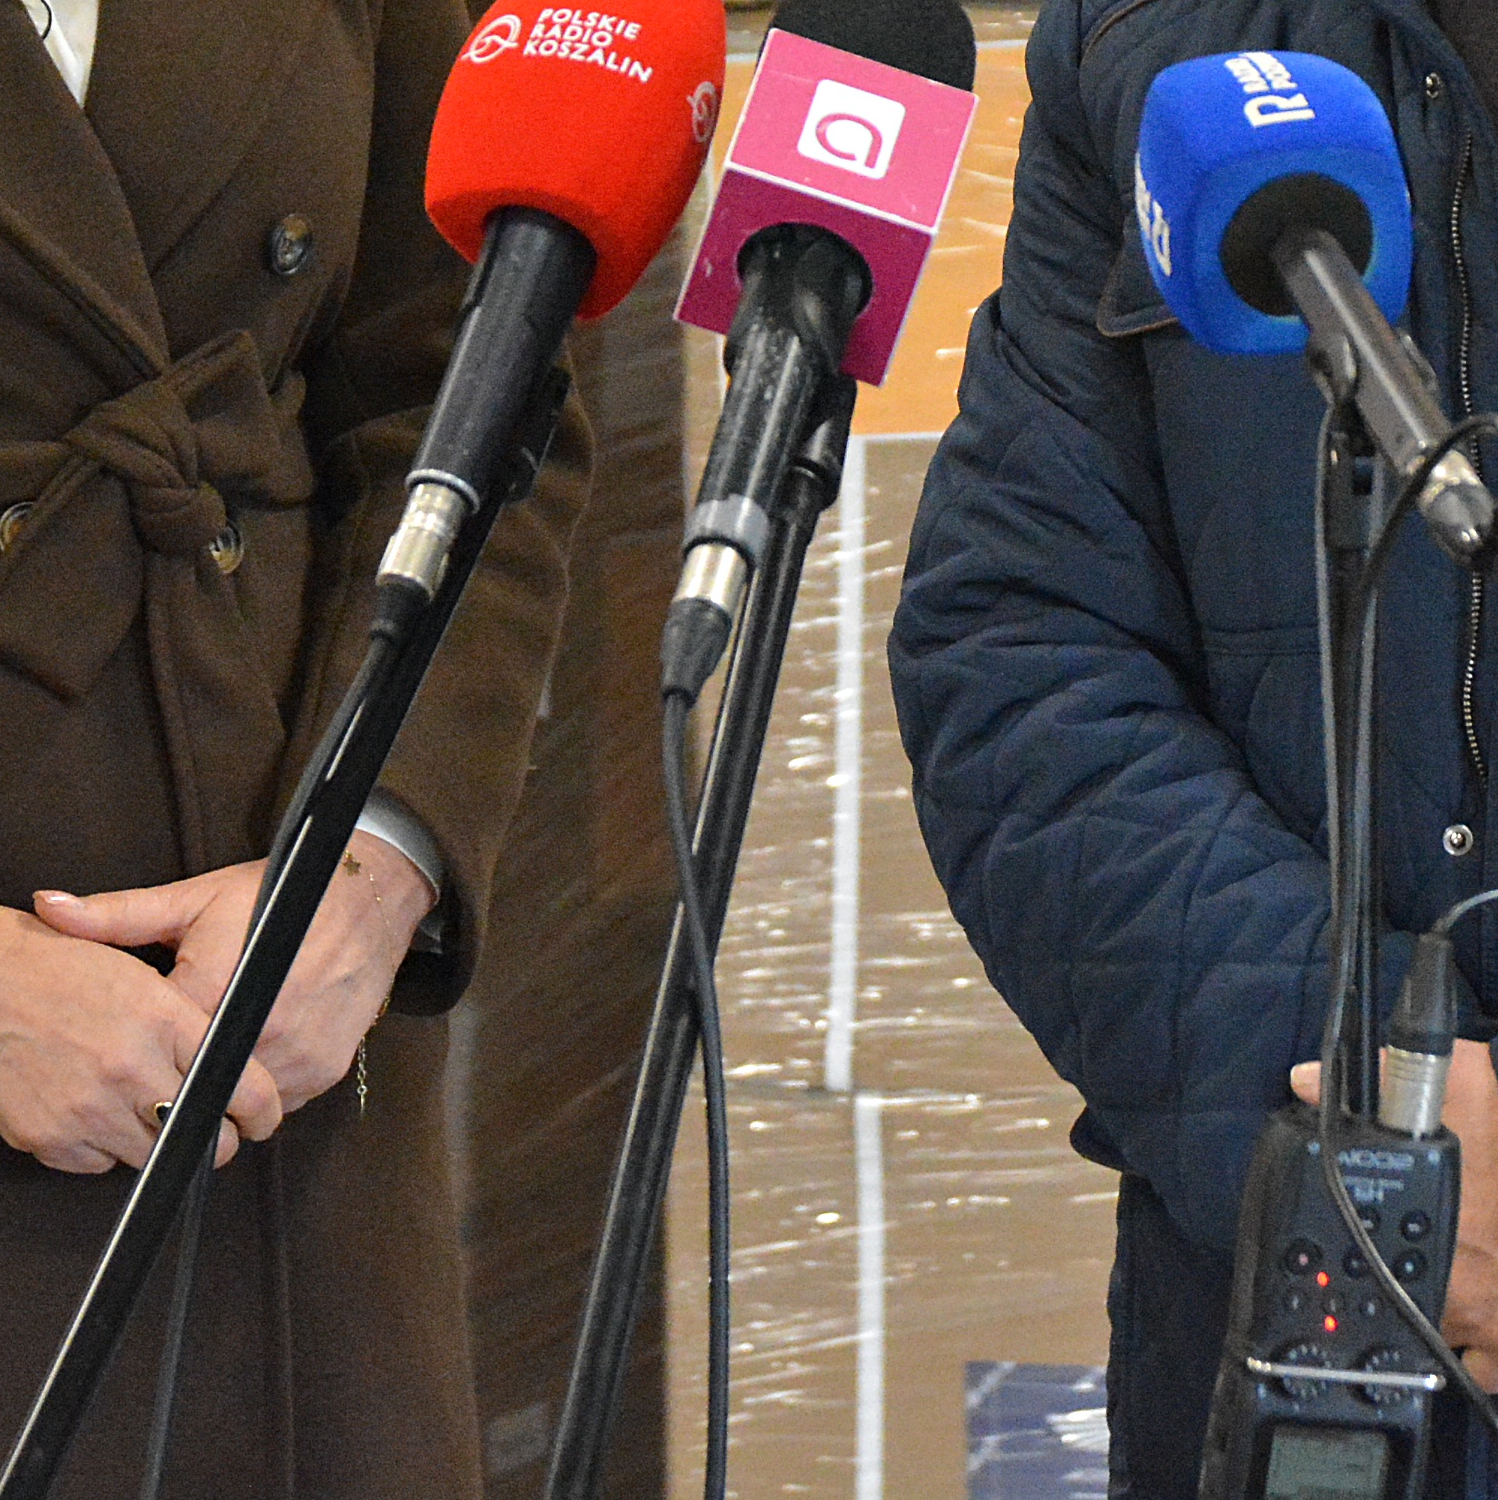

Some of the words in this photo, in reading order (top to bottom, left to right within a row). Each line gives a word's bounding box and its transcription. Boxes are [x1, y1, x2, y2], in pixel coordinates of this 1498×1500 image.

[529, 22, 614, 48] RADIO
[537, 7, 643, 41] POLSKIE
[522, 37, 654, 84] KOSZALIN
